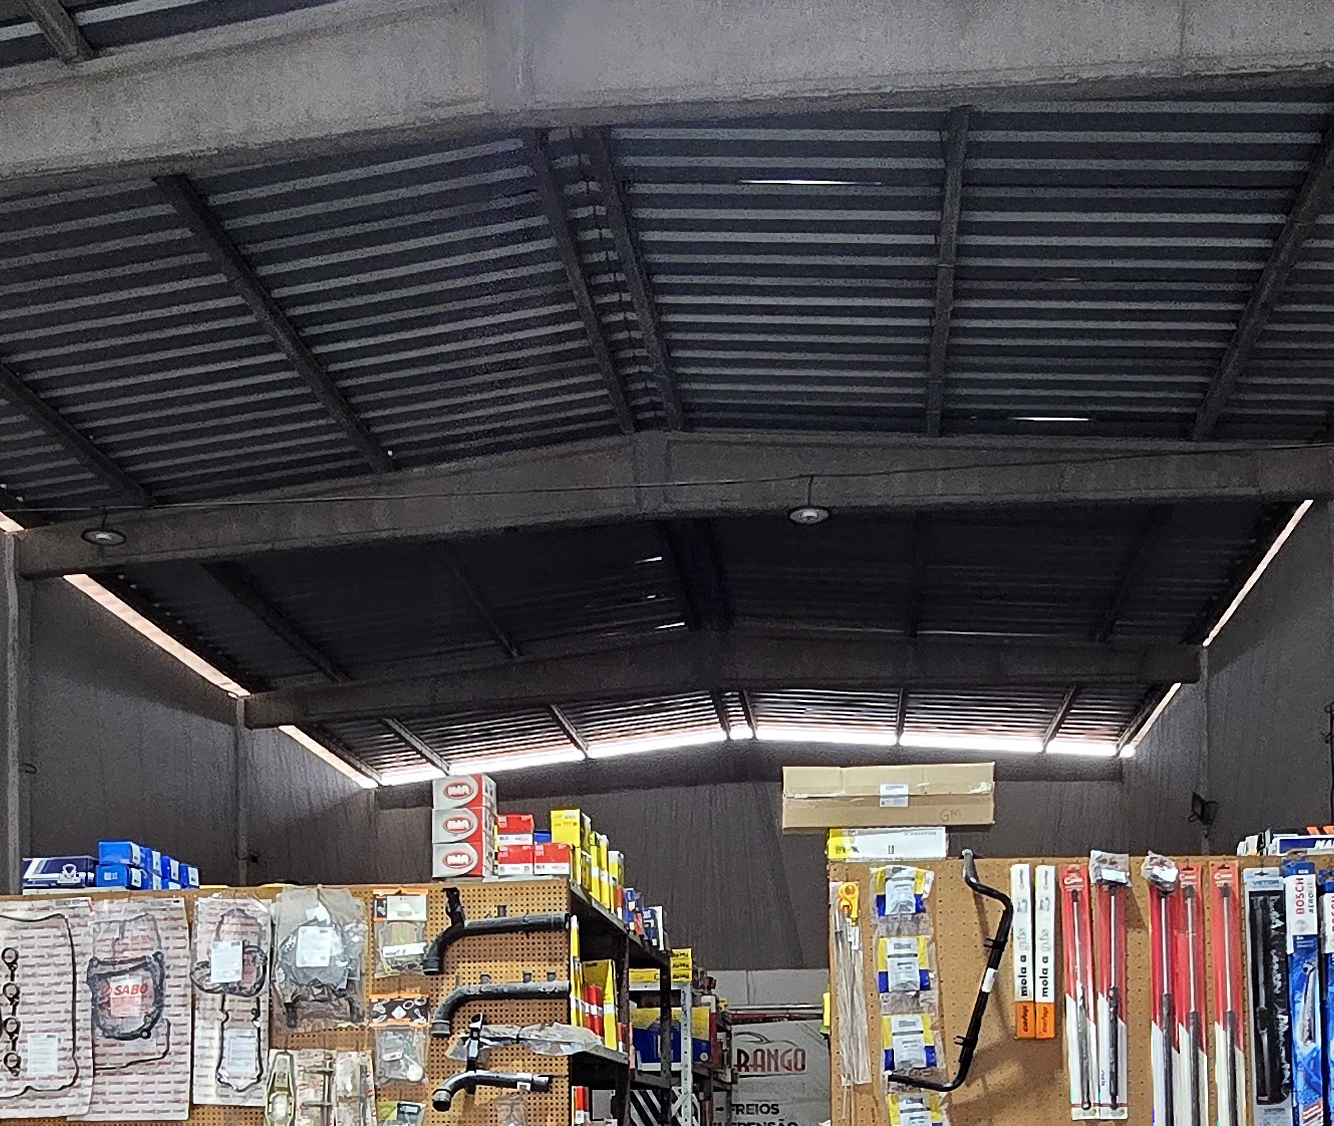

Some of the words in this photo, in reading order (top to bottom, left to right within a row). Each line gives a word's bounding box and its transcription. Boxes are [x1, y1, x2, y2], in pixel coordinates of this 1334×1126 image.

[1295, 877, 1305, 915] BOSCH
[1019, 967, 1030, 998] mola
[1039, 967, 1050, 998] mola
